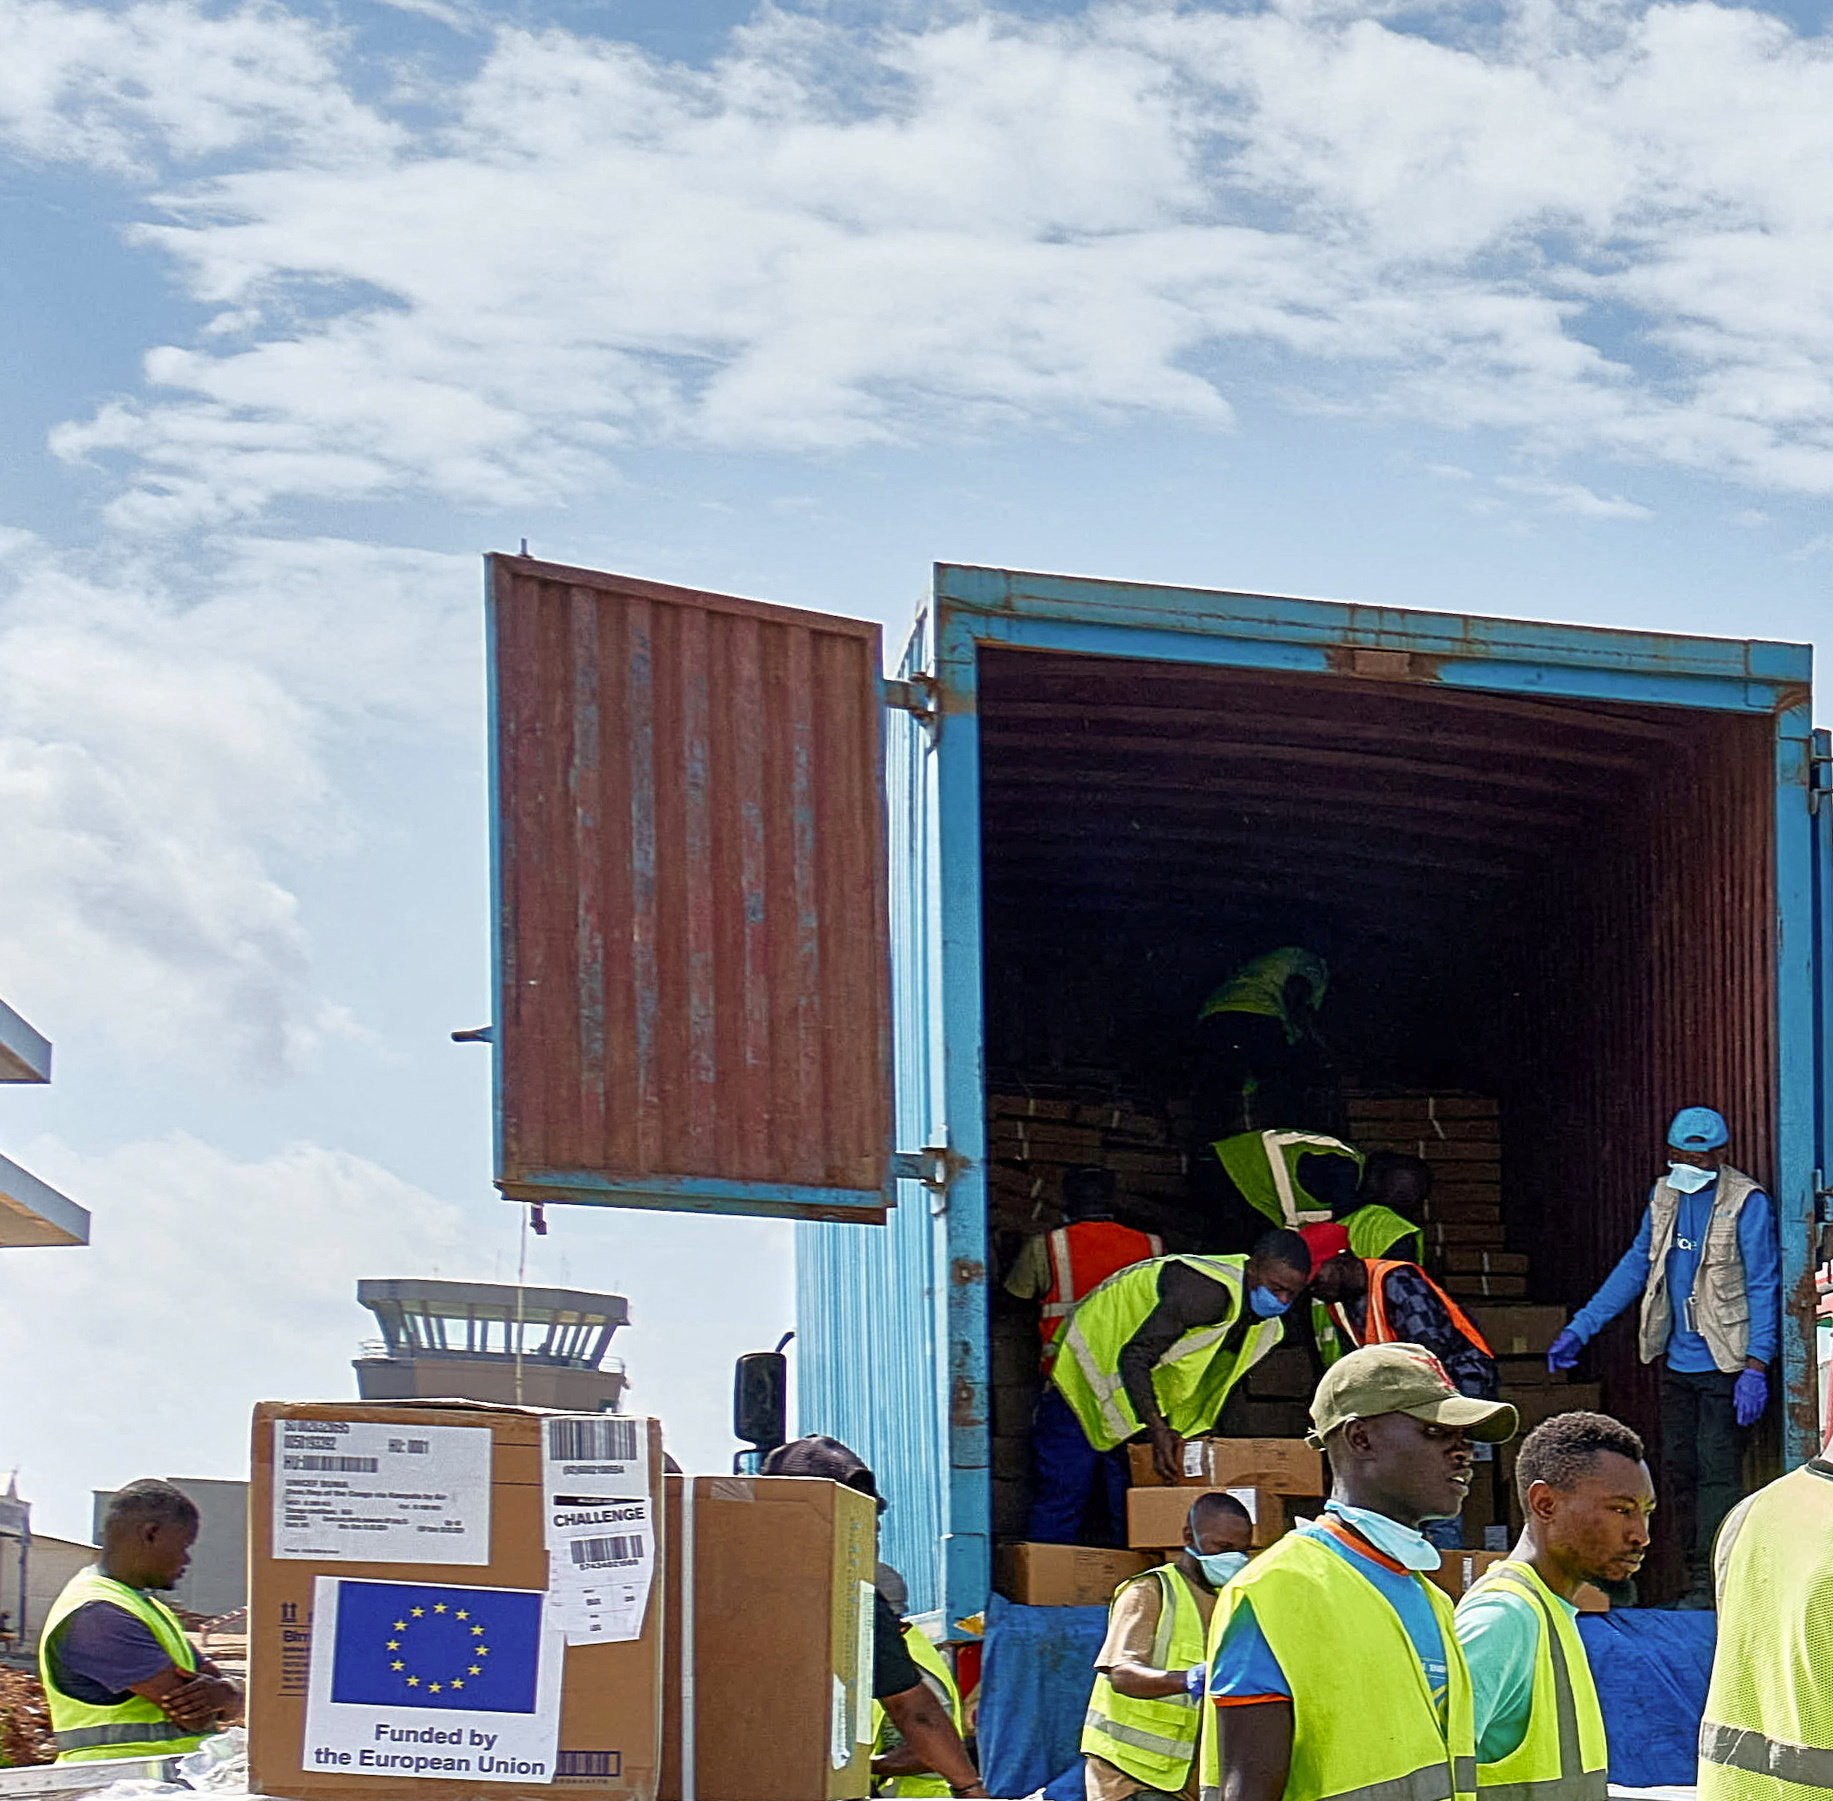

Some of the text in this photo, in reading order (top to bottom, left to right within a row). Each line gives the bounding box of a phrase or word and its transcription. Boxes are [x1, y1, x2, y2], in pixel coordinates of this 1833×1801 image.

[553, 1507, 645, 1527] CHALLENGE
[375, 1724, 498, 1750] Funded by
[315, 1747, 545, 1776] the European Union
